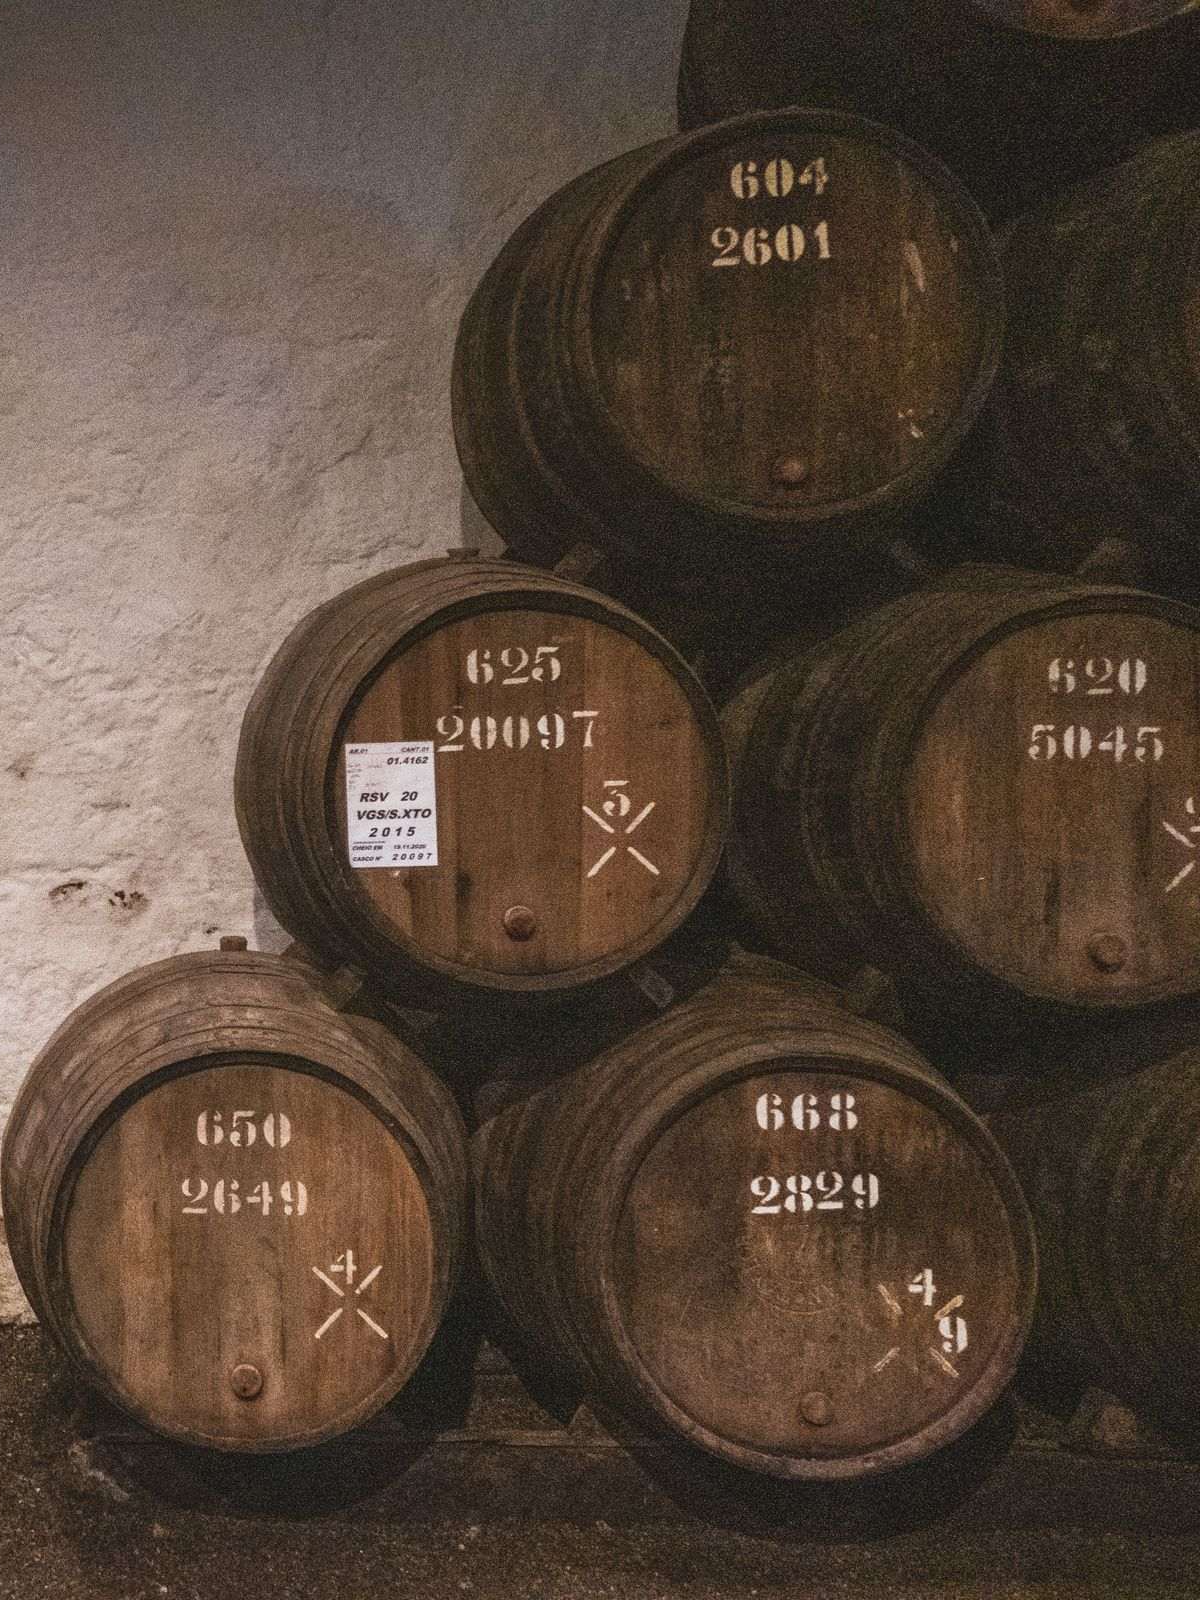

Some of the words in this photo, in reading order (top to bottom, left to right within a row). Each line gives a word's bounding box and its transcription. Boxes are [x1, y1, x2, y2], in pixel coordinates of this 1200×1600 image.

[730, 157, 829, 199] 604
[711, 220, 831, 267] 2601
[466, 646, 561, 685] 625
[1048, 658, 1147, 694] 620
[436, 710, 599, 752] 20097
[1028, 724, 1163, 762] 5045
[387, 756, 429, 766] 01.4162
[357, 808, 432, 820] VGS/S.XTO
[360, 792, 390, 802] RSV
[400, 791, 418, 801] 20
[197, 1110, 291, 1148] 650
[755, 1093, 858, 1131] 668
[181, 1178, 308, 1216] 2649
[750, 1171, 879, 1214] 2829
[330, 1249, 357, 1284] 4
[908, 1268, 936, 1306] 4
[938, 1316, 968, 1353] 9
